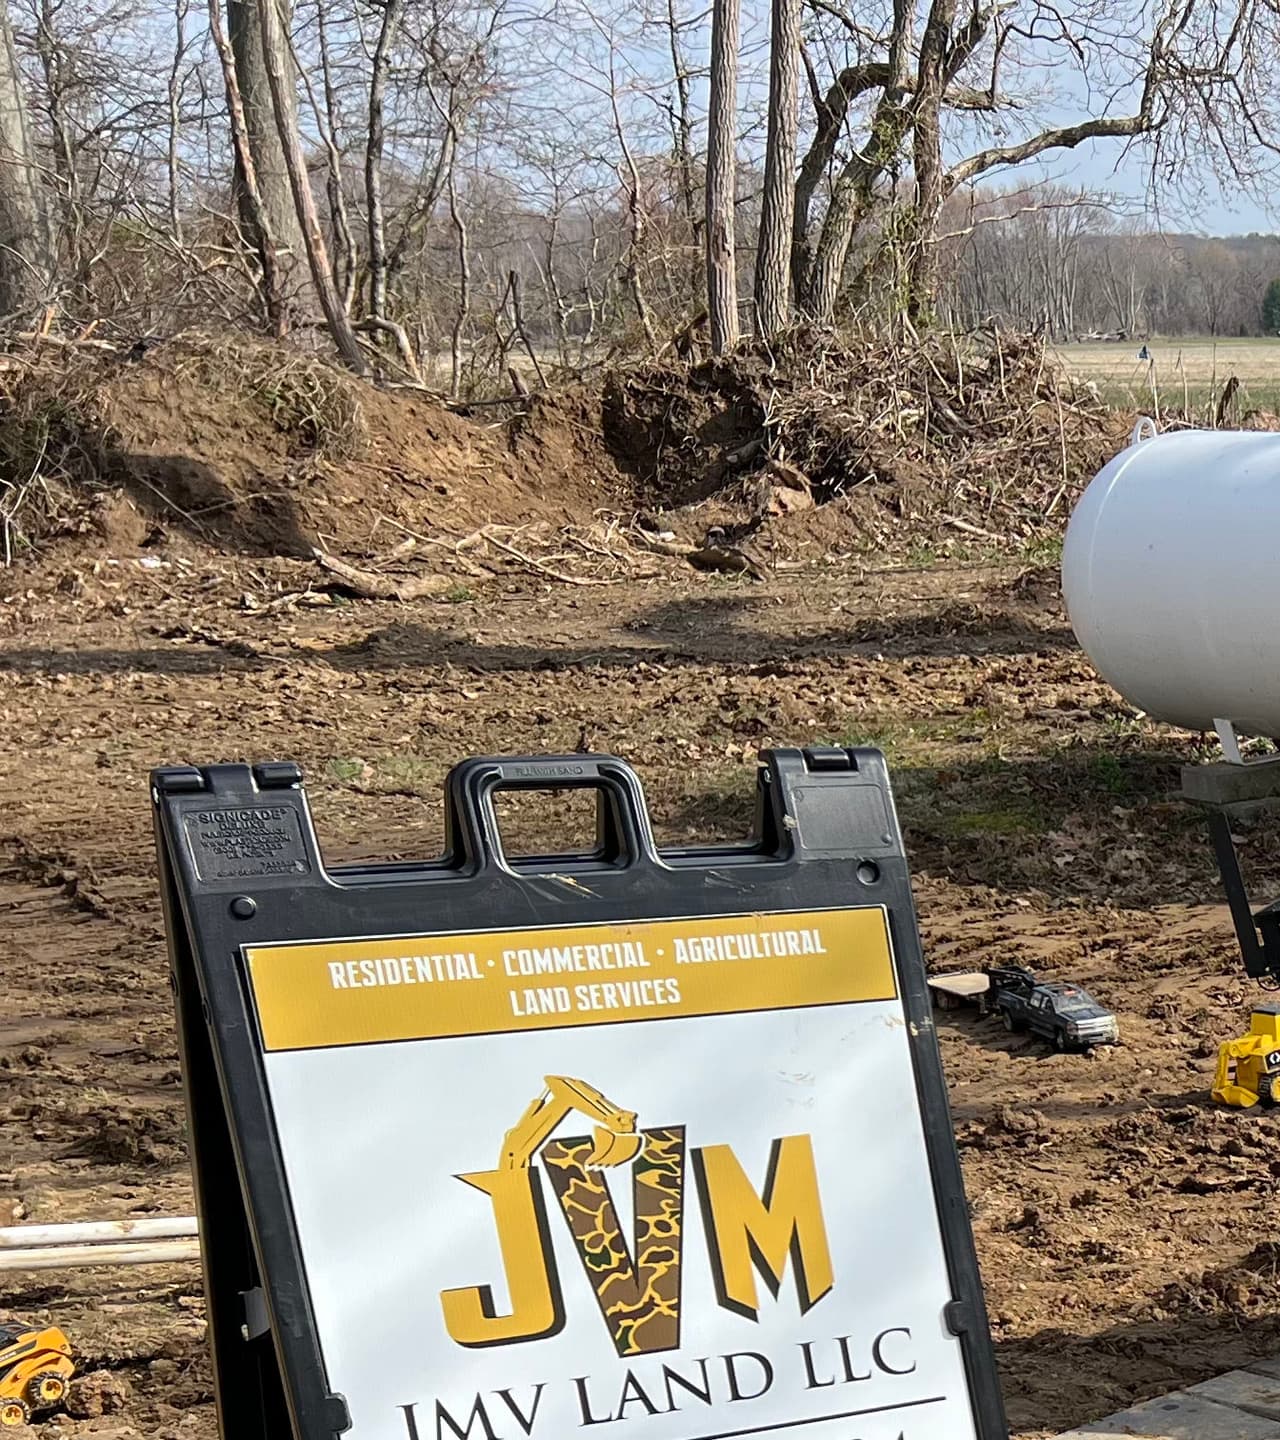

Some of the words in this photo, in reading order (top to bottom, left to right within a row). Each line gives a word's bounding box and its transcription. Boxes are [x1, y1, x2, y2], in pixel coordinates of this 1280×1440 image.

[327, 952, 485, 990] RESIDENTIAL
[502, 940, 651, 977] COMMERCIAL
[673, 928, 828, 965] AGRICULTURAL
[509, 986, 574, 1018] LAND
[575, 977, 682, 1012] SERVICES
[440, 1120, 835, 1359] JVM
[570, 1350, 774, 1428] LAND
[795, 1326, 918, 1391] LLC
